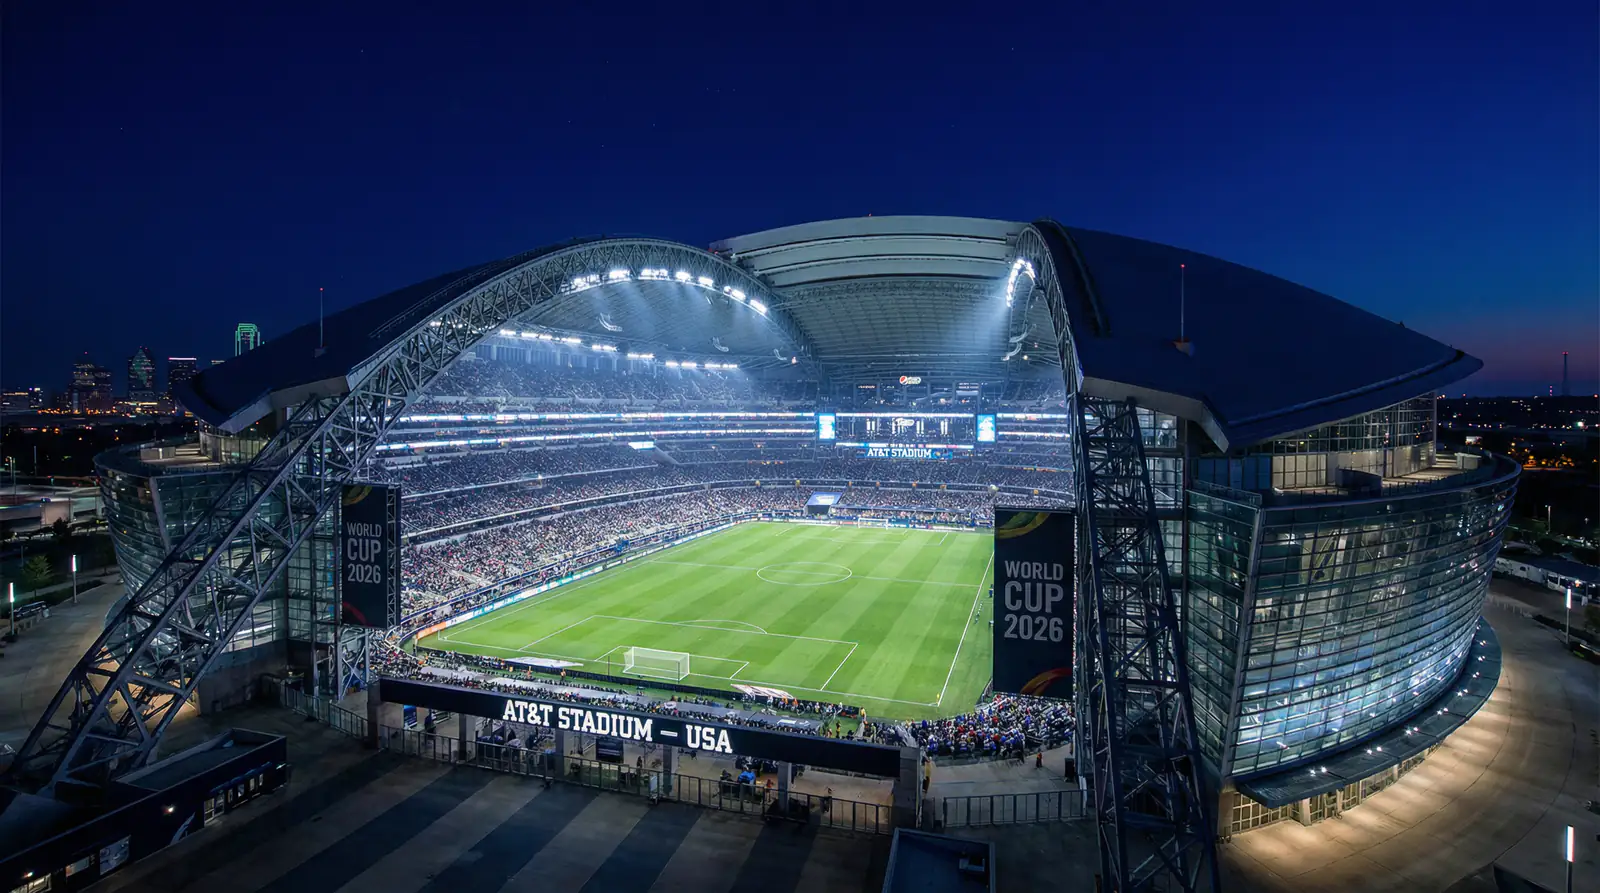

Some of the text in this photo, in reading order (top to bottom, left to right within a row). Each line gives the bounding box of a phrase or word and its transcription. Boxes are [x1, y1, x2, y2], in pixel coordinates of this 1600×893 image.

[867, 447, 932, 458] AT&T STADIUM
[347, 521, 382, 537] WORLD
[347, 538, 382, 562] CUP
[347, 563, 382, 584] 2026
[1004, 560, 1064, 581] WORLD
[1004, 581, 1064, 613] CUP
[1004, 614, 1064, 642] 2026
[503, 699, 554, 727] AT&T
[558, 707, 653, 742] STADIUM
[686, 725, 733, 754] USA
